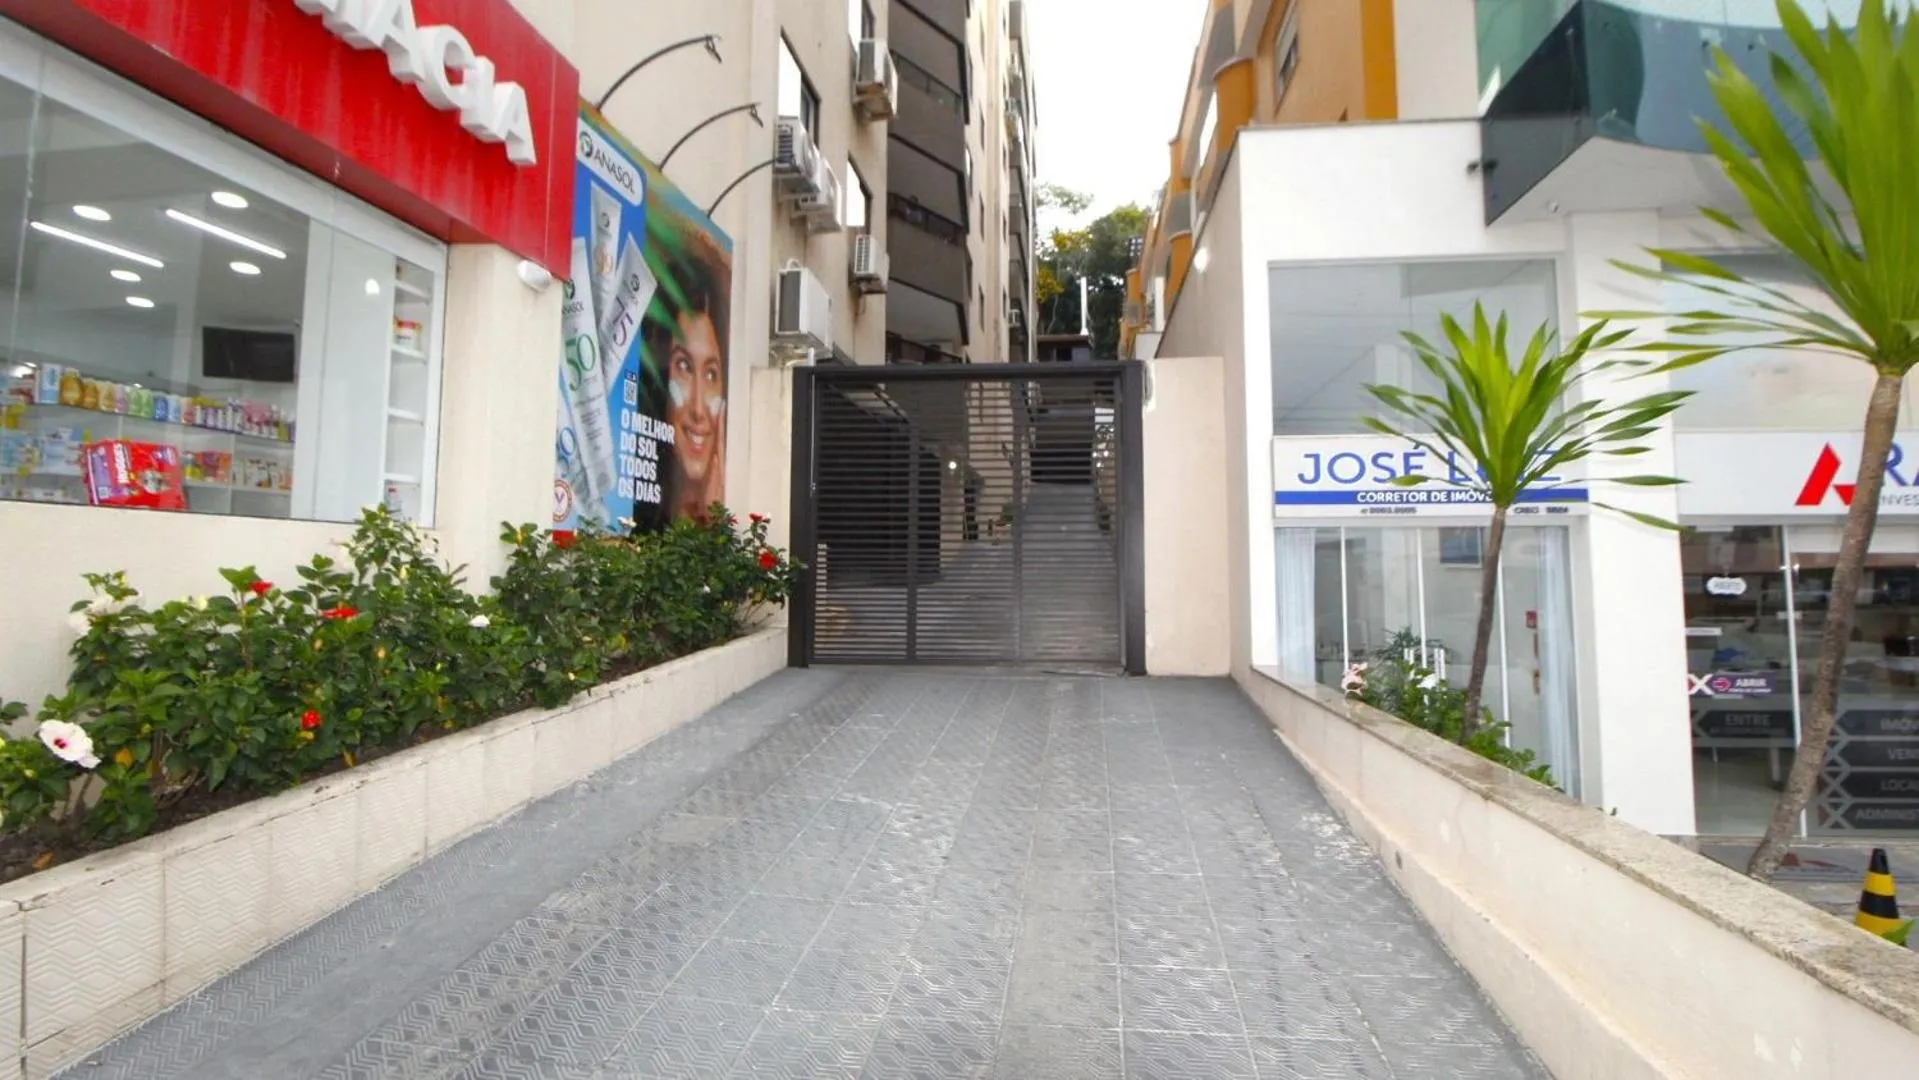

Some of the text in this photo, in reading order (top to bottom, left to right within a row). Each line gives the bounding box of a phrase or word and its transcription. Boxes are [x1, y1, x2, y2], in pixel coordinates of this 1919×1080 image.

[296, 0, 537, 166] ACIA
[594, 151, 635, 193] ANASOL
[565, 333, 596, 392] 50
[620, 409, 630, 430] O
[631, 412, 676, 445] MELHOR
[620, 431, 637, 454] DO
[637, 437, 660, 462] SOL
[619, 454, 657, 482] TODOS
[1298, 442, 1561, 485] JOSÉ LZ
[1883, 441, 1919, 487] R
[618, 476, 662, 504] OS DIAS
[1357, 488, 1493, 503] CORRETOR DE IMÓV
[1725, 714, 1771, 726] ENTRE
[1888, 748, 1919, 760] VEN
